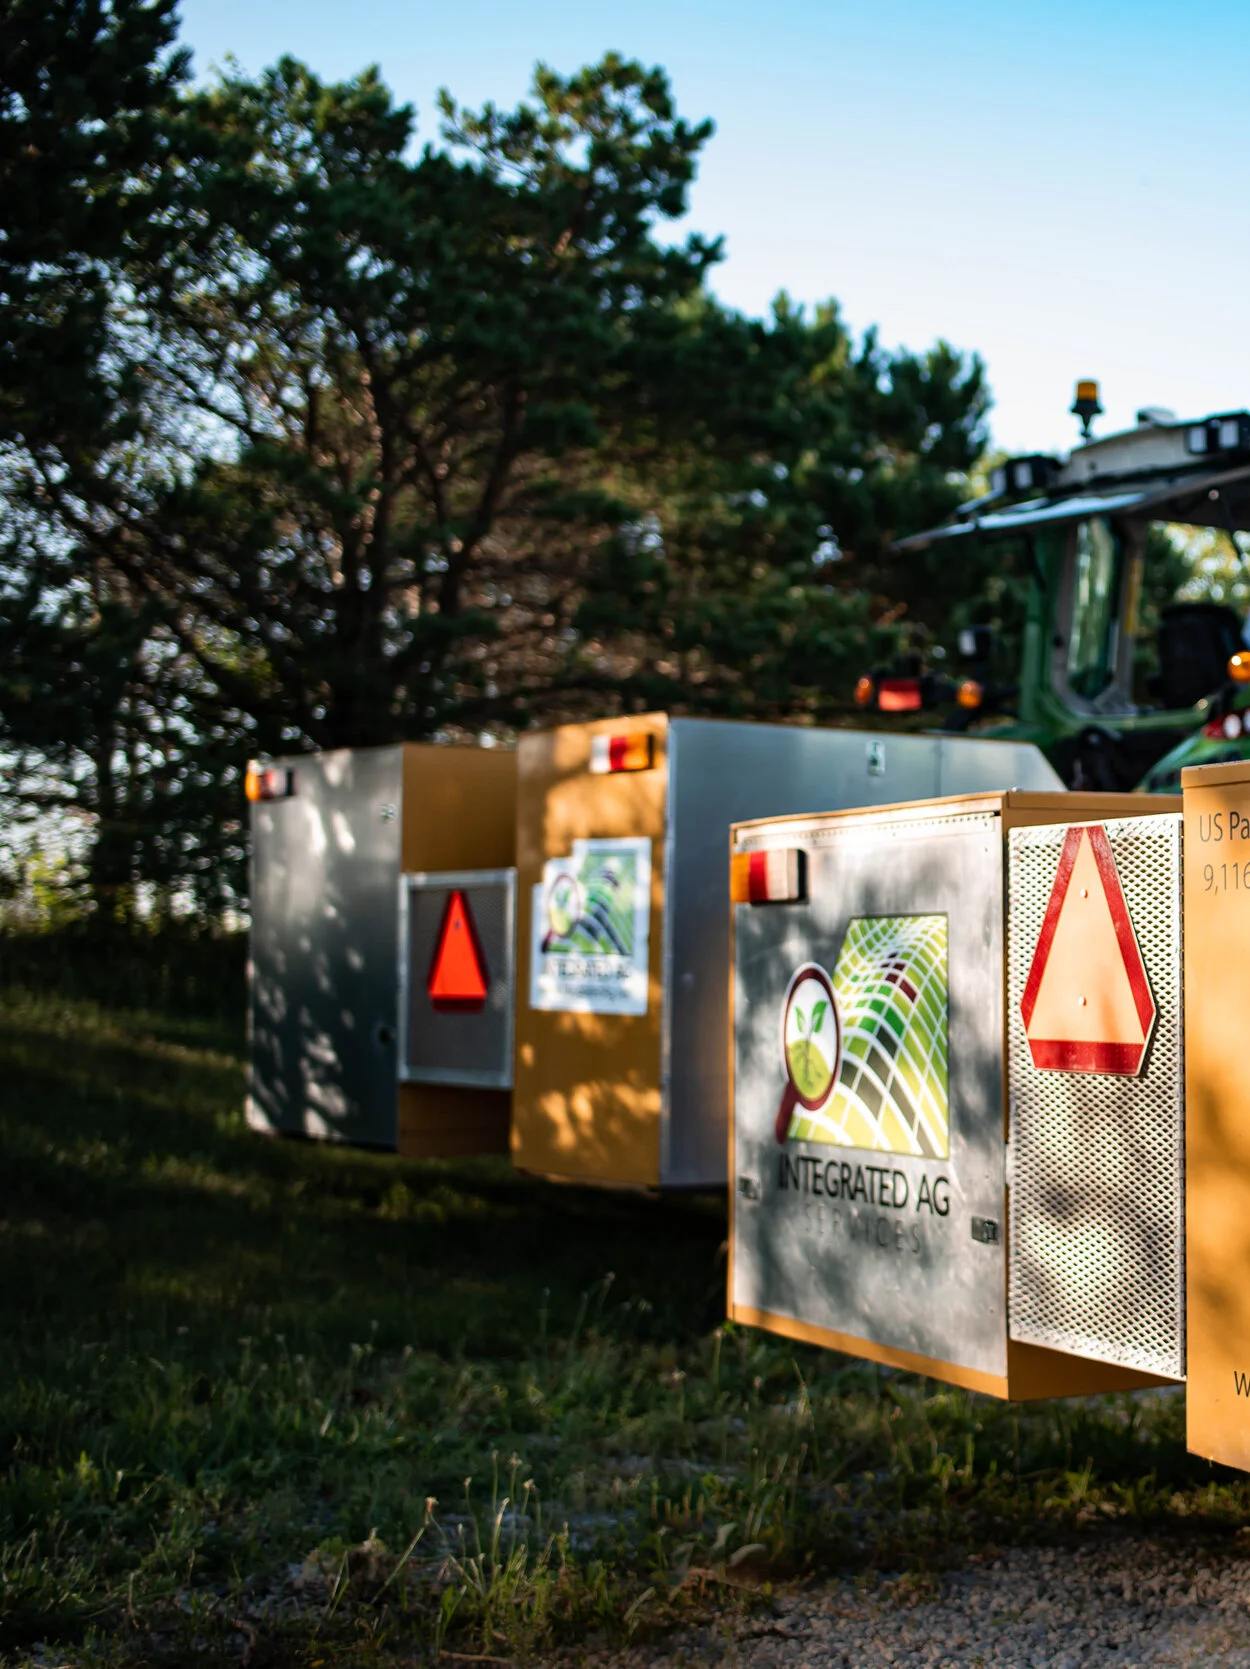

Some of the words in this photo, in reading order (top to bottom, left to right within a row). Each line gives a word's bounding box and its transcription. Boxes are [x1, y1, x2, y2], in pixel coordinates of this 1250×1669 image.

[1199, 812, 1223, 842] US
[778, 1154, 909, 1209] INTEGRATED
[916, 1174, 950, 1217] AG
